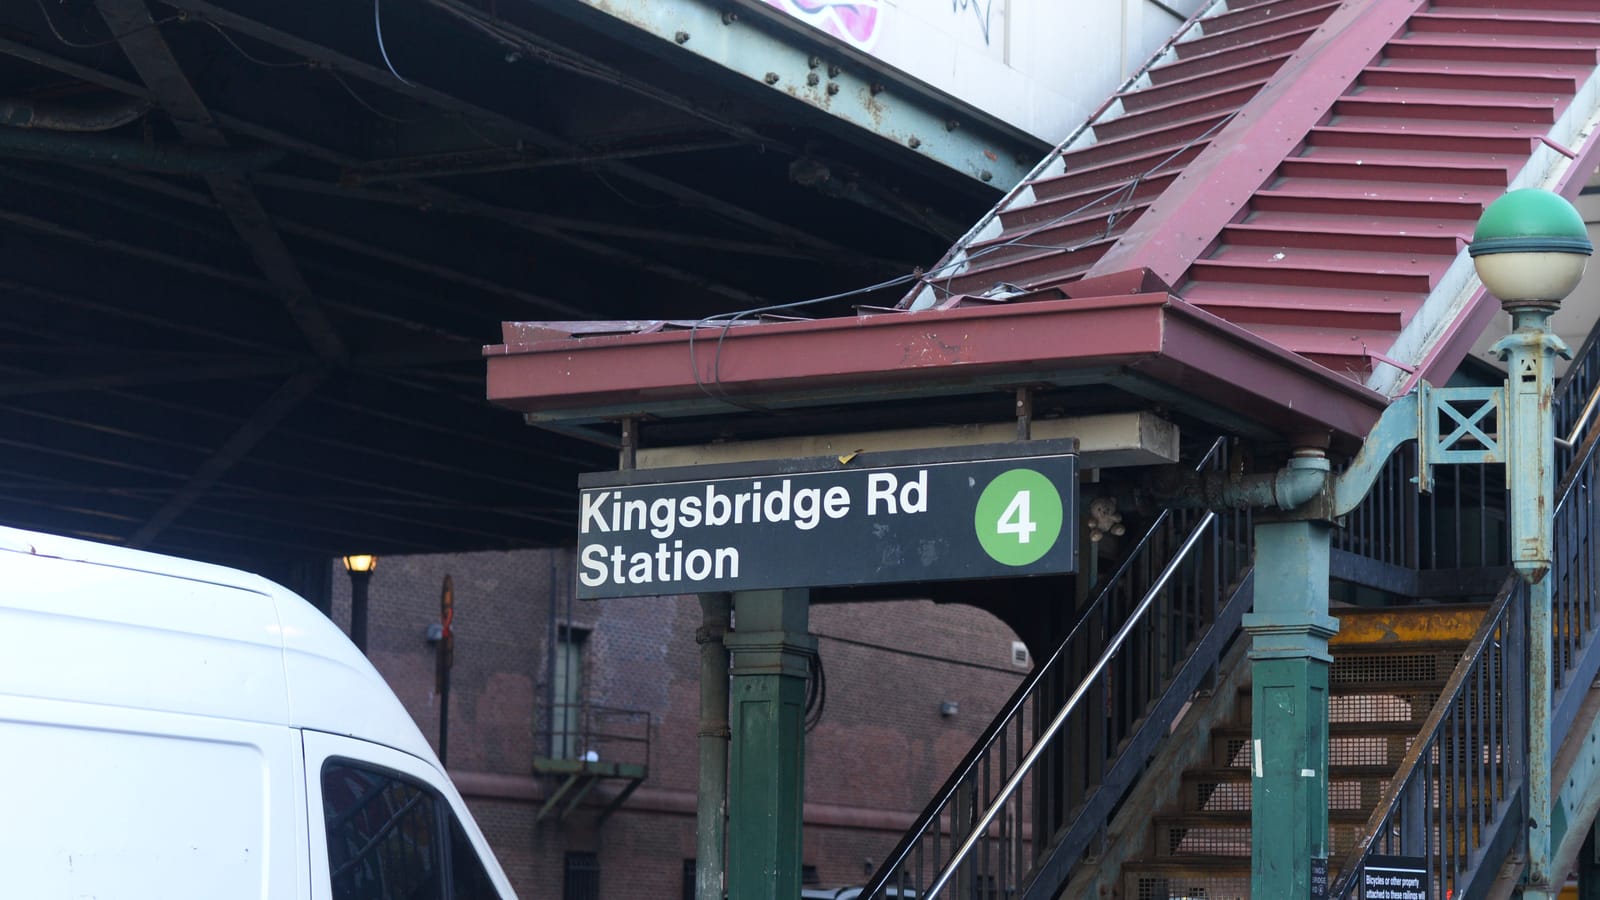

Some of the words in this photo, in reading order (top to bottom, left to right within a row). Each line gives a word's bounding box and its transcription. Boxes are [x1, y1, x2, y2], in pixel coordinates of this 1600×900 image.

[581, 479, 850, 539] Kingsbridge
[867, 470, 928, 515] Rd
[997, 490, 1036, 543] 4
[579, 540, 739, 587] Station
[1366, 875, 1385, 887] Bicycles
[1390, 876, 1402, 886] other
[1402, 878, 1420, 889] property
[1366, 889, 1385, 899] attached
[1385, 890, 1390, 899] to
[1390, 890, 1402, 899] these
